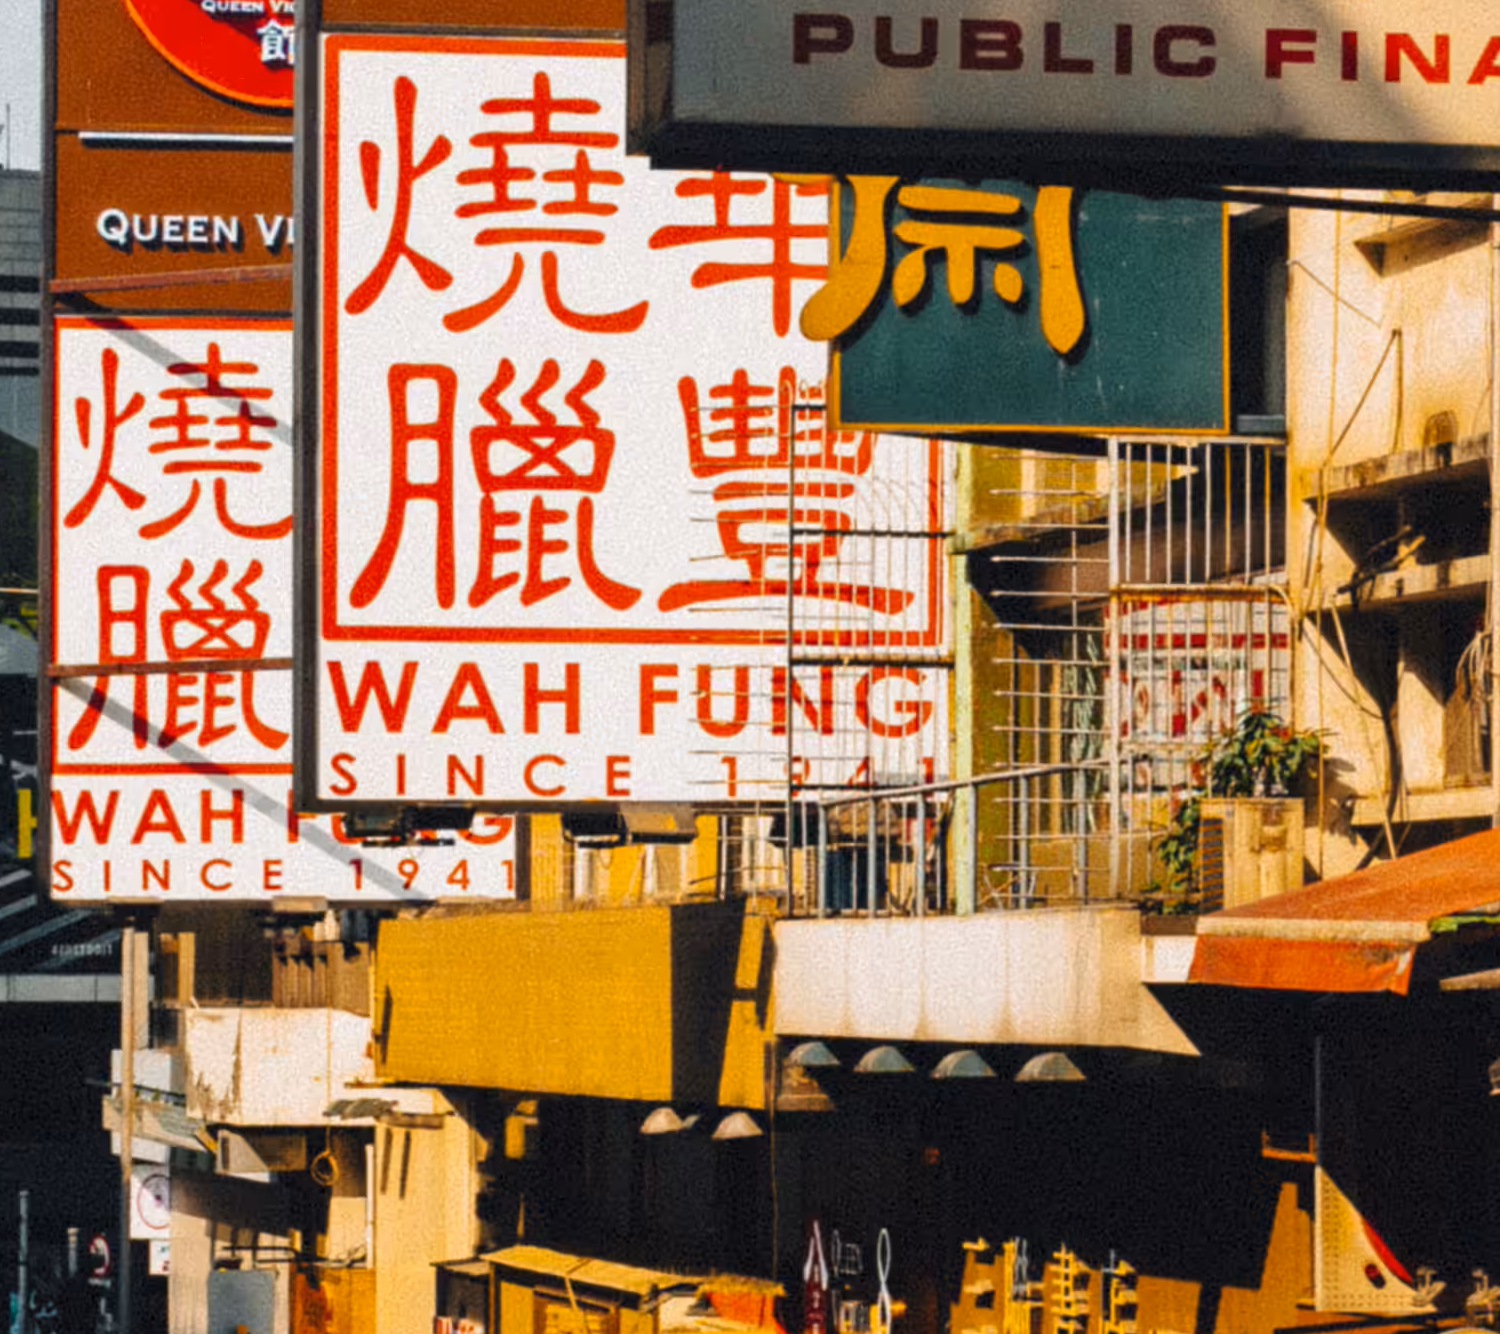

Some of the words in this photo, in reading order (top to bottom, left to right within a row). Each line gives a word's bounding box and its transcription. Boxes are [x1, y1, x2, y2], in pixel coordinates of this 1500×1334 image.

[792, 13, 1219, 79] PUBLIC
[97, 208, 238, 245] QUEEN
[328, 660, 582, 736] WAH
[639, 662, 934, 738] FUNG
[330, 752, 632, 798] SINCE
[719, 755, 938, 801] 1941
[51, 788, 244, 845] WAH
[52, 857, 284, 893] SINCE
[350, 857, 517, 893] 1941
